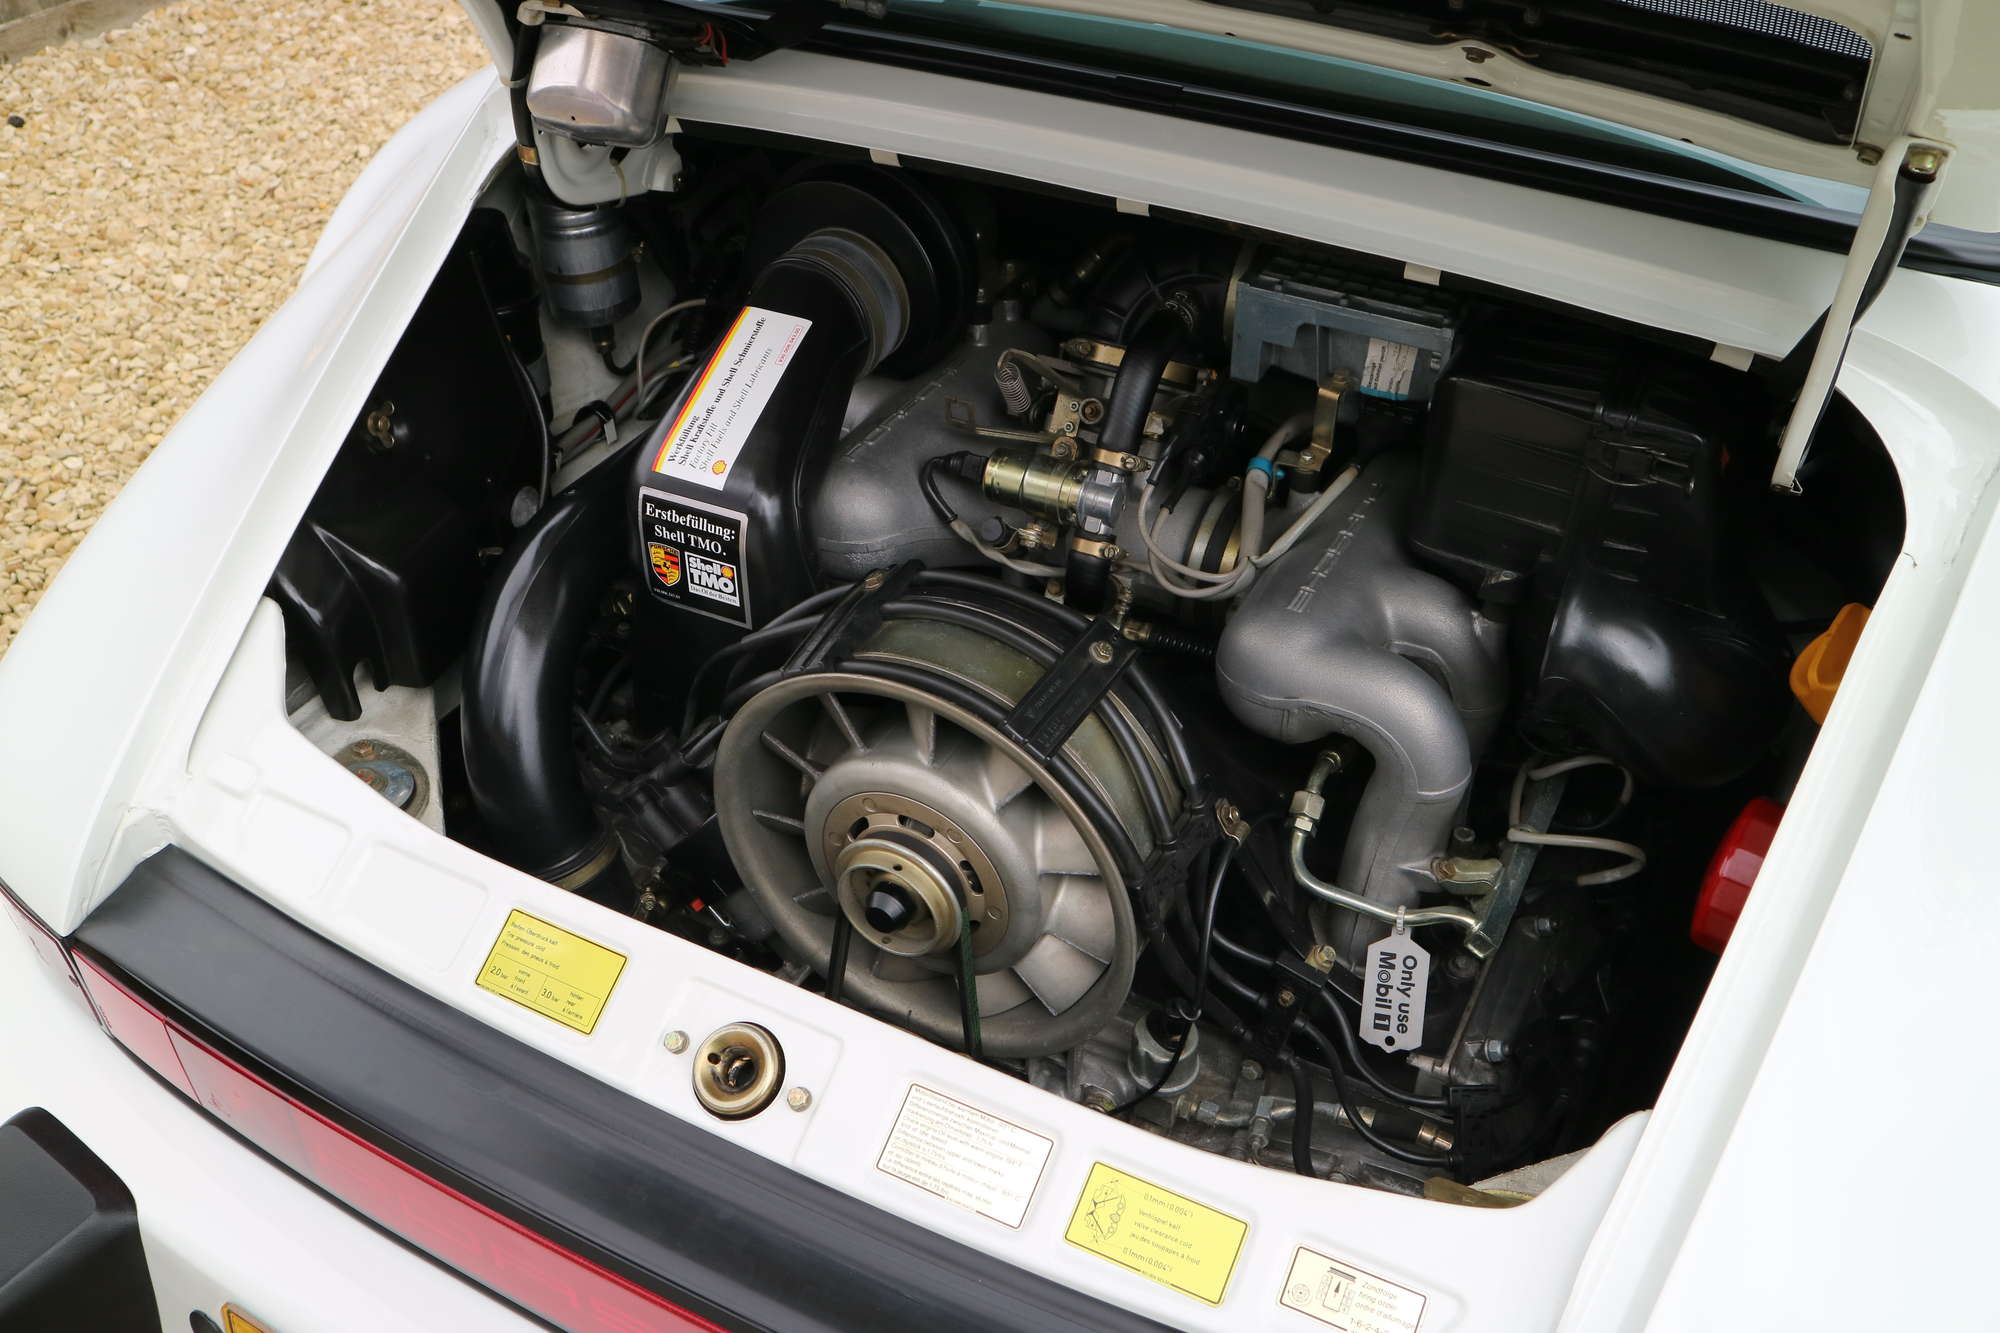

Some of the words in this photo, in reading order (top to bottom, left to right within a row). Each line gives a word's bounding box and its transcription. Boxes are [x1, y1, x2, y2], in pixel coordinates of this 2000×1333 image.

[679, 446, 693, 466] Shell
[691, 404, 717, 443] Kraftstoffe
[714, 389, 725, 403] und
[723, 368, 737, 387] Shell
[734, 317, 766, 366] Schmierstoffe
[699, 450, 715, 471] Shell
[712, 429, 726, 448] Fuels
[724, 410, 736, 426] and
[734, 390, 749, 408] Shell
[746, 348, 772, 388] Lubricants
[669, 415, 699, 462] Werkfüllung
[689, 439, 710, 469] Factory
[705, 423, 718, 437] Fill
[645, 503, 735, 540] Erstbefüllung:
[655, 525, 685, 543] Shell
[688, 535, 726, 556] TMO.
[689, 557, 721, 576] Shell
[690, 569, 734, 593] TMO
[1375, 952, 1396, 1010] Mobil
[1397, 955, 1417, 998] Only
[1374, 1013, 1391, 1031] 1
[1397, 1003, 1409, 1034] use
[1179, 1240, 1191, 1248] cold
